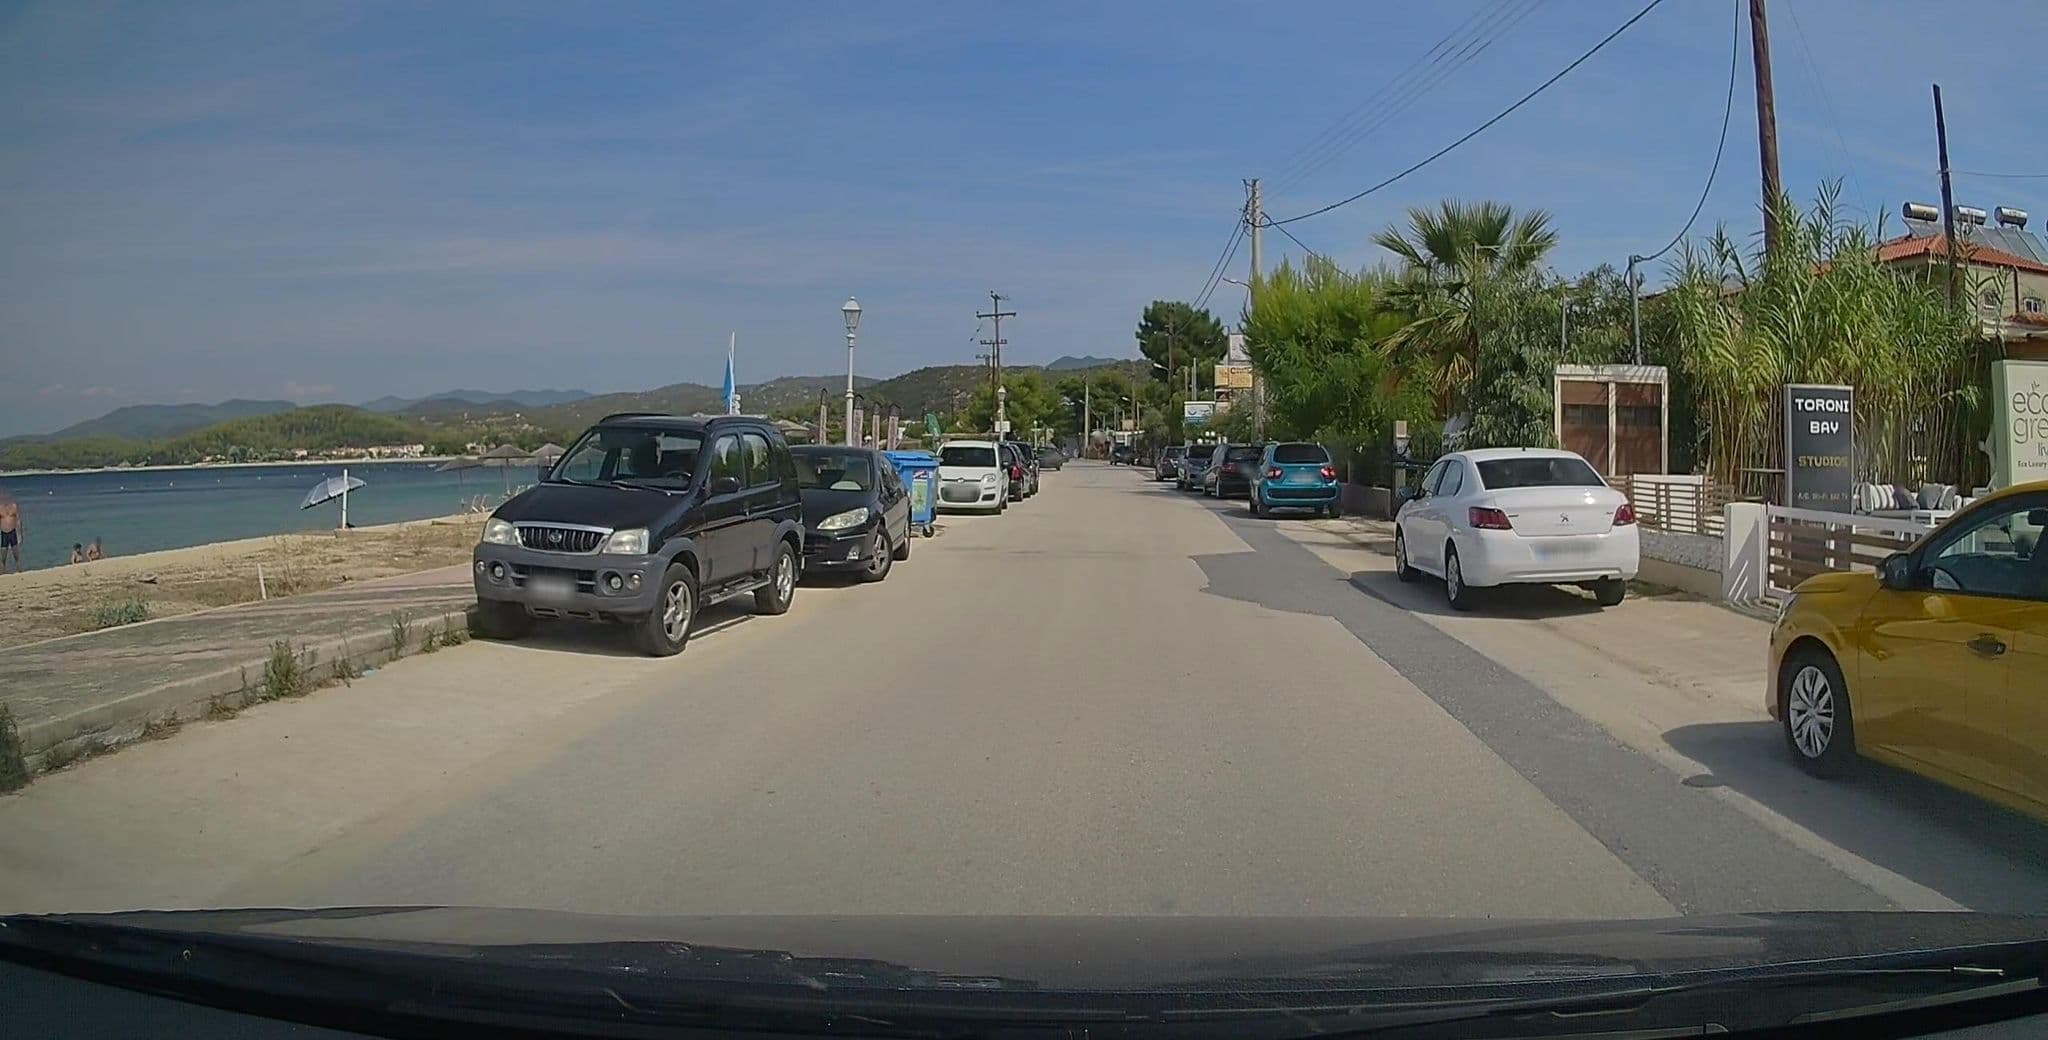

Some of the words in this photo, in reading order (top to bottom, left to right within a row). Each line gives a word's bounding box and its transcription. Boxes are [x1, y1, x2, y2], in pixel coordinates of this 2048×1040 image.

[1795, 398, 1849, 413] TORONI
[1810, 421, 1839, 434] BAY
[1798, 456, 1848, 467] STUDIOS
